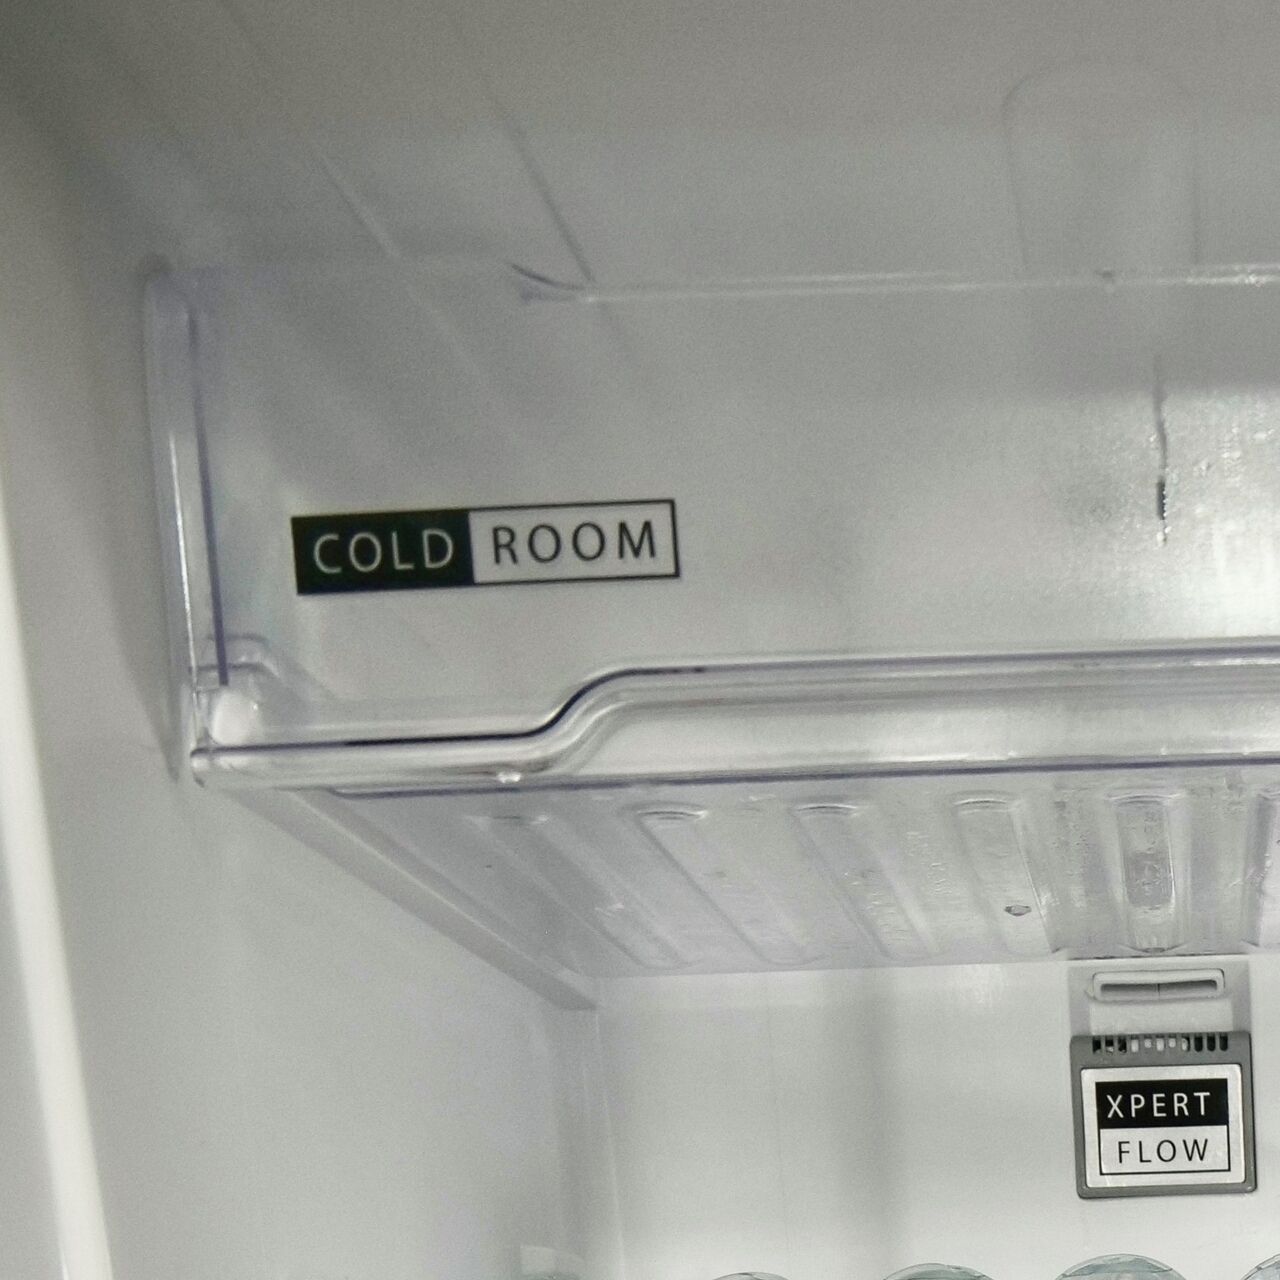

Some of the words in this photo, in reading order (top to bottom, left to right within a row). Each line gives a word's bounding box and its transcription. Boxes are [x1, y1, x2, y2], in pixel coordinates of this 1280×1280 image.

[312, 527, 454, 574] COLD
[491, 520, 657, 566] ROOM
[1106, 1091, 1211, 1119] XPERT
[1117, 1138, 1209, 1164] FLOW
